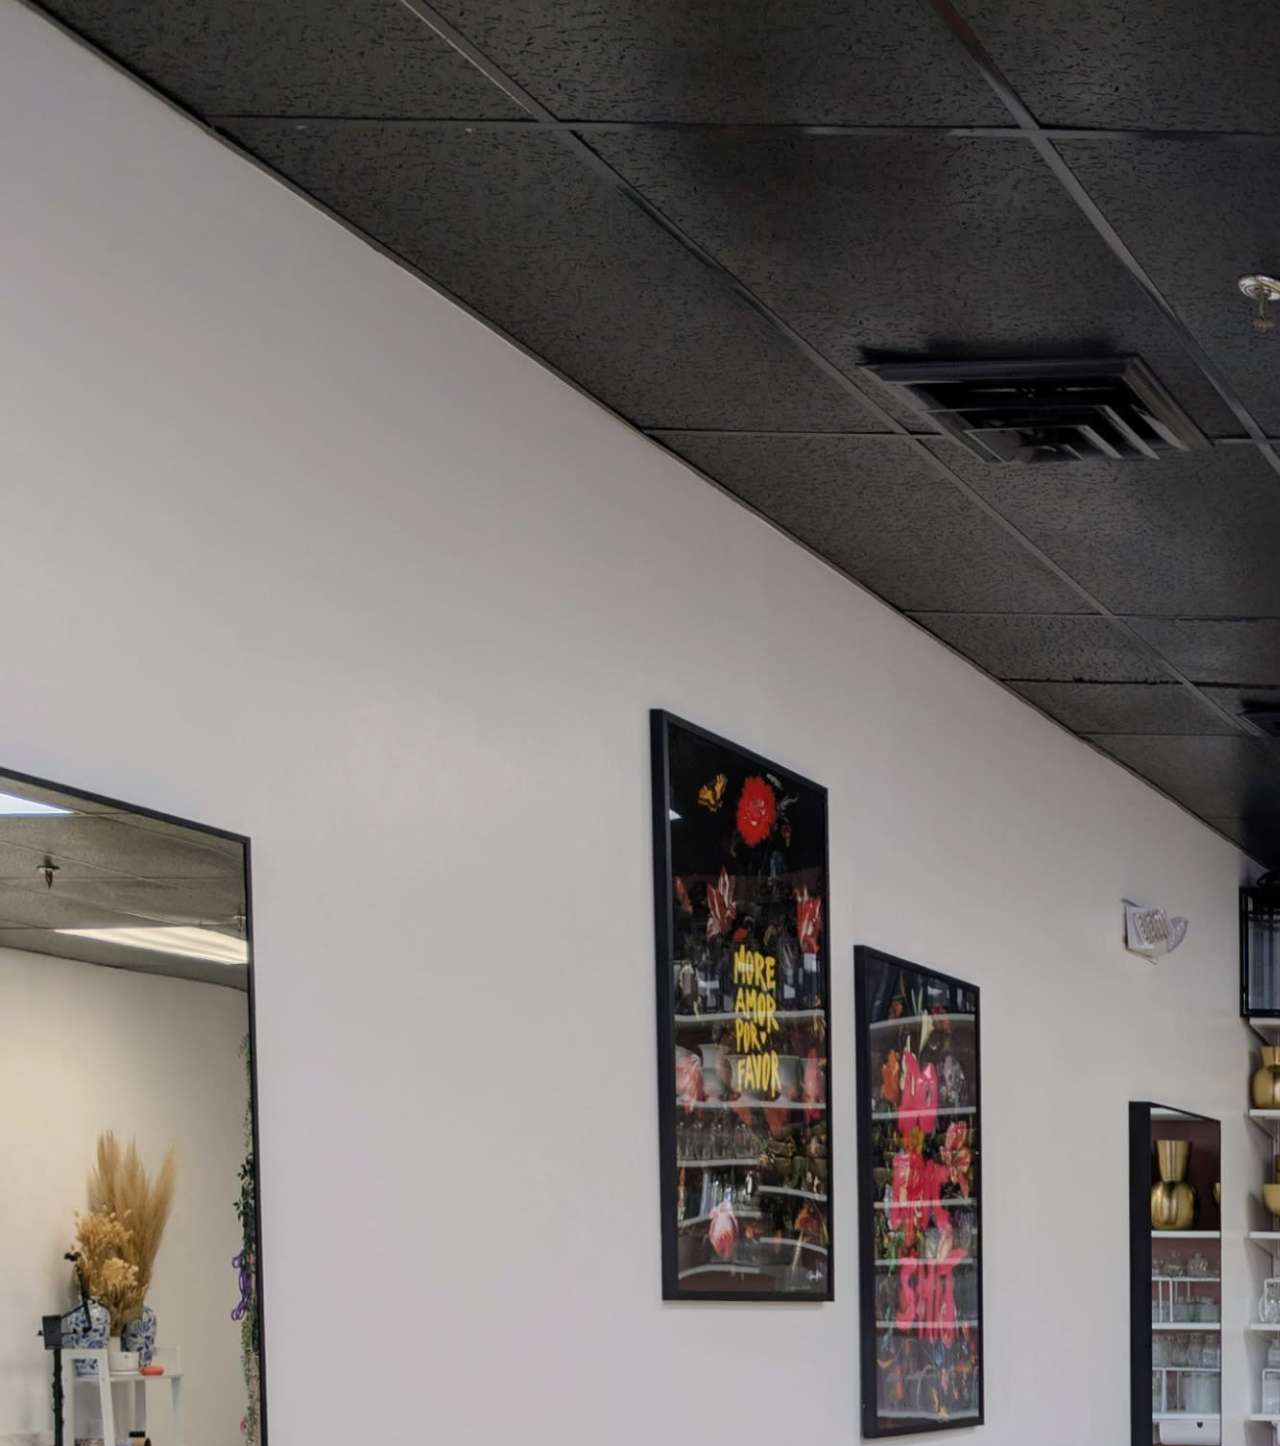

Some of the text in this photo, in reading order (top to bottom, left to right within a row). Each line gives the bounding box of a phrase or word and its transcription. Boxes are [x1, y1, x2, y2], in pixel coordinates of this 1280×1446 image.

[734, 944, 777, 991] MORE
[735, 987, 780, 1034] AMOR
[735, 1017, 762, 1053] POR
[737, 1050, 783, 1099] FAVOR
